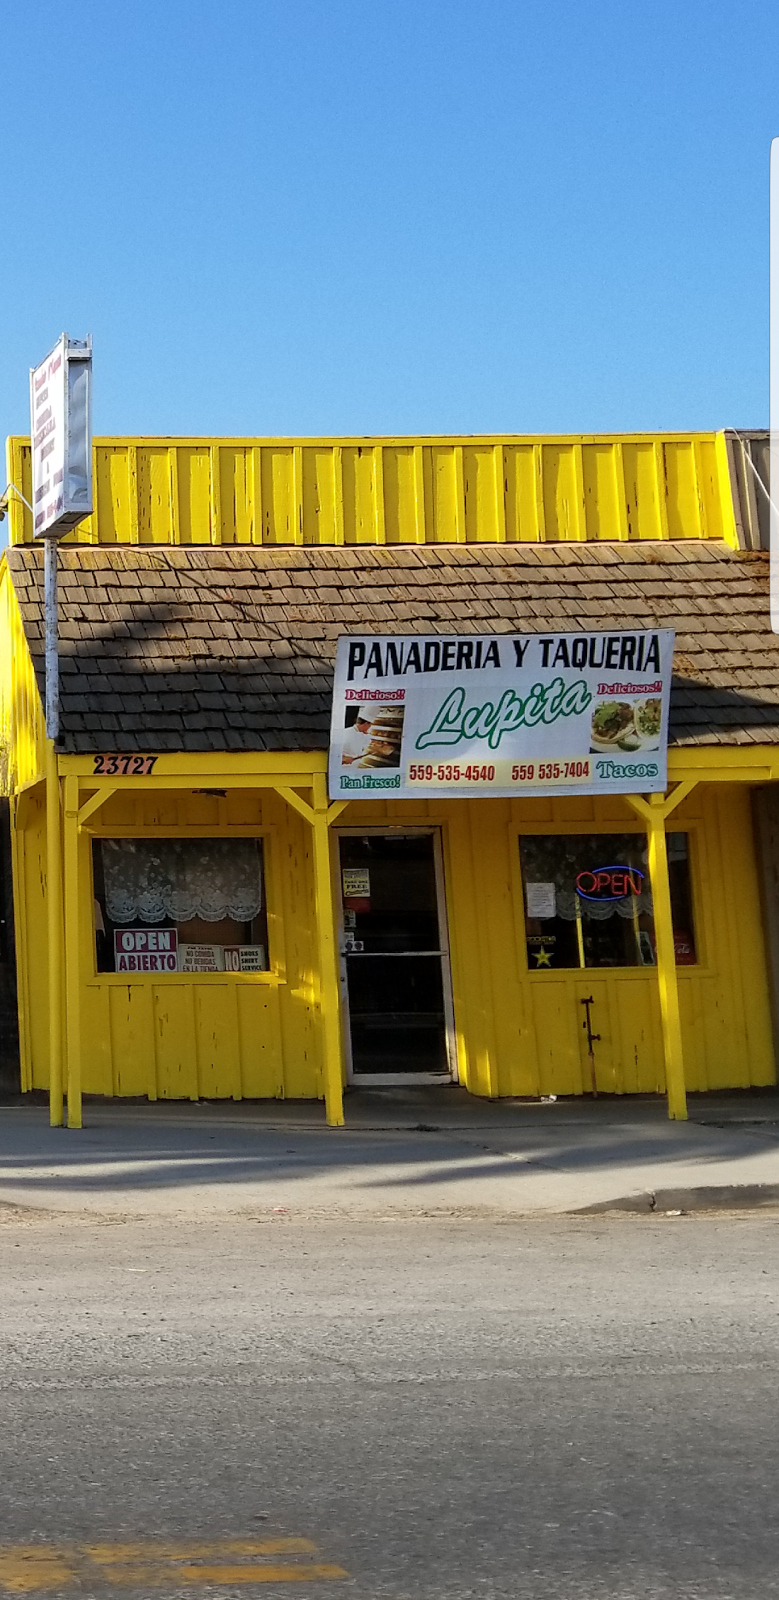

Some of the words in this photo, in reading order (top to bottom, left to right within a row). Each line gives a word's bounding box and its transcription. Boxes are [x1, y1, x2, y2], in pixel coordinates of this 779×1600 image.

[347, 640, 501, 681] PANADERIA
[511, 639, 530, 668] Y
[539, 634, 661, 674] TAQUERIA
[345, 689, 405, 700] Delicioso!!
[597, 681, 662, 694] Deliciosos!!
[415, 677, 592, 750] Lupita
[93, 755, 159, 774] 23727
[409, 765, 495, 782] 559-535-4540
[511, 765, 534, 780] 559
[538, 761, 590, 779] 535-7404
[596, 761, 659, 778] Tacos
[340, 776, 362, 789] Pan
[362, 775, 401, 789] Fresco!
[576, 871, 642, 896] OPEN
[121, 932, 171, 951] OPEN
[119, 954, 176, 971] ABIERTO
[224, 951, 240, 971] NO
